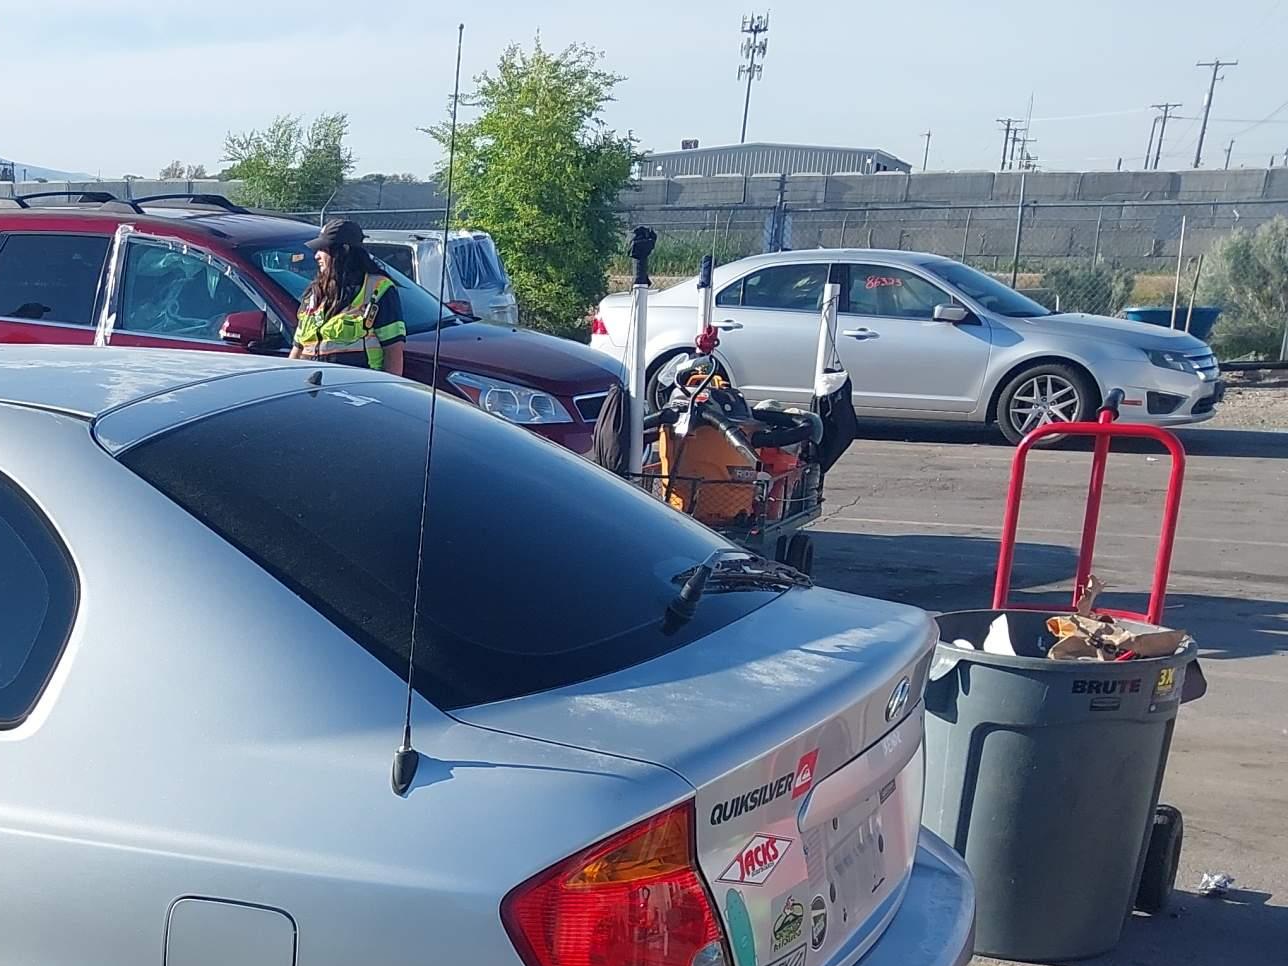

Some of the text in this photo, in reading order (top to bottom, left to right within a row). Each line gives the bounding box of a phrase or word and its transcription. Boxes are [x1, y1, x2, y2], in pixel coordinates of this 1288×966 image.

[1158, 668, 1176, 685] 3X
[1072, 679, 1142, 694] BRUTE
[710, 772, 794, 826] QUIKSILVER
